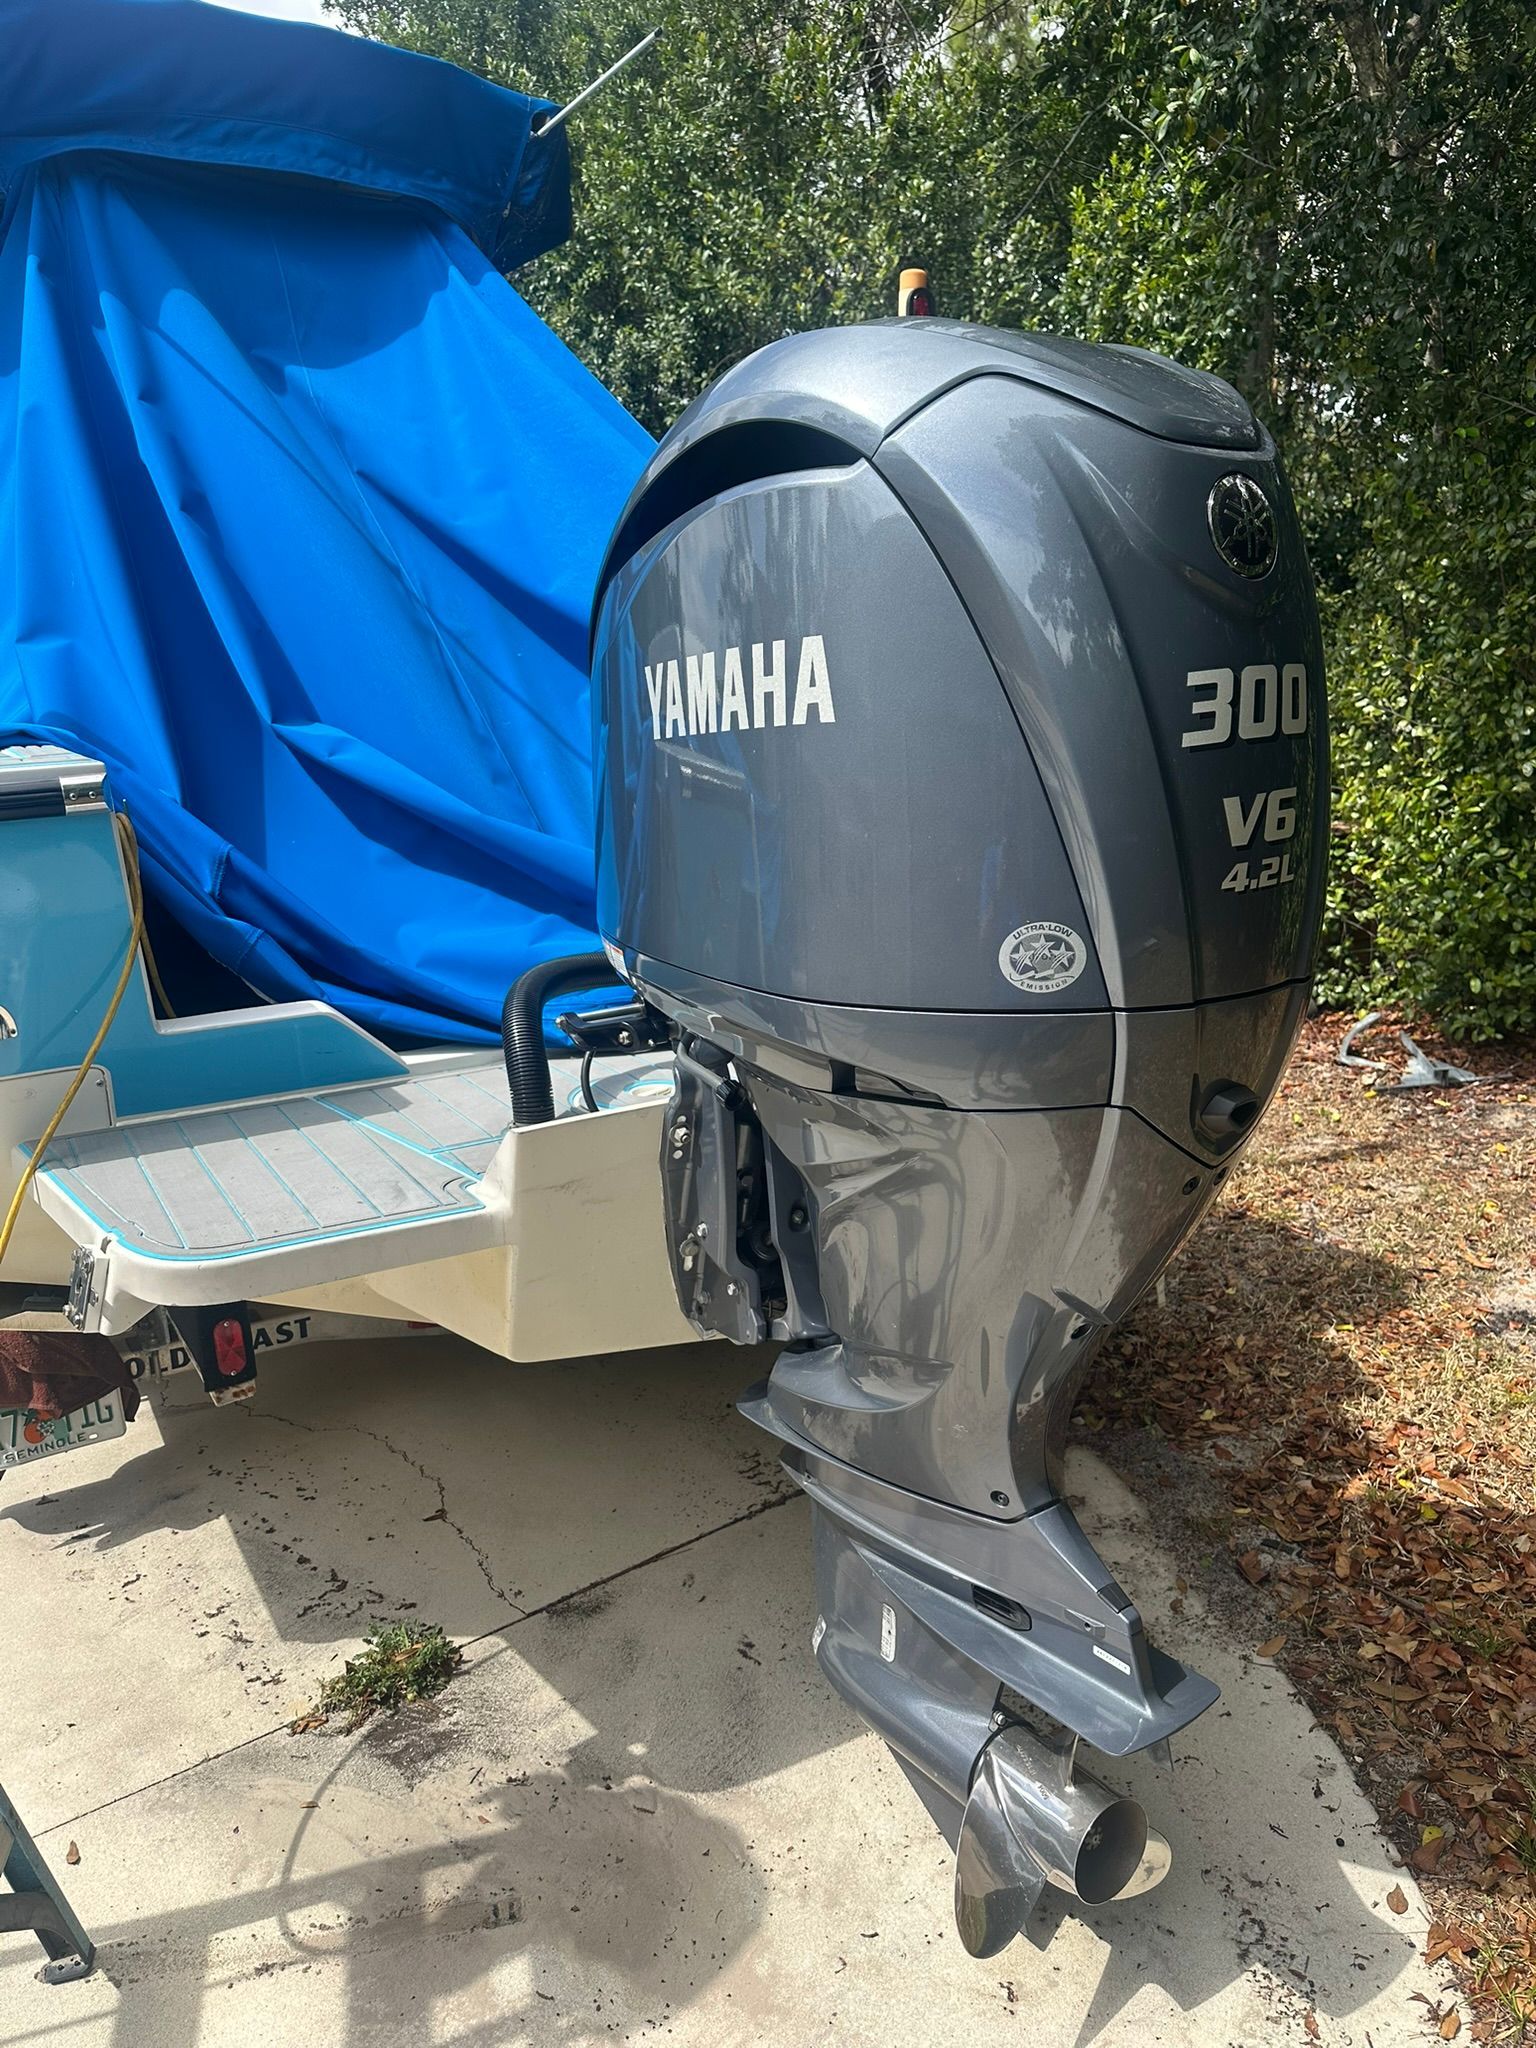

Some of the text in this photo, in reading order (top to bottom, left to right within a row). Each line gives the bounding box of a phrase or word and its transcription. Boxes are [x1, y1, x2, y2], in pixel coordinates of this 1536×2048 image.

[643, 634, 836, 740] YAMAHA
[1181, 663, 1308, 749] 300
[1222, 786, 1298, 848] V6
[1220, 853, 1295, 893] 4.2L
[1019, 978, 1069, 991] EMISSION
[4, 1432, 88, 1465] SEMINOLE
